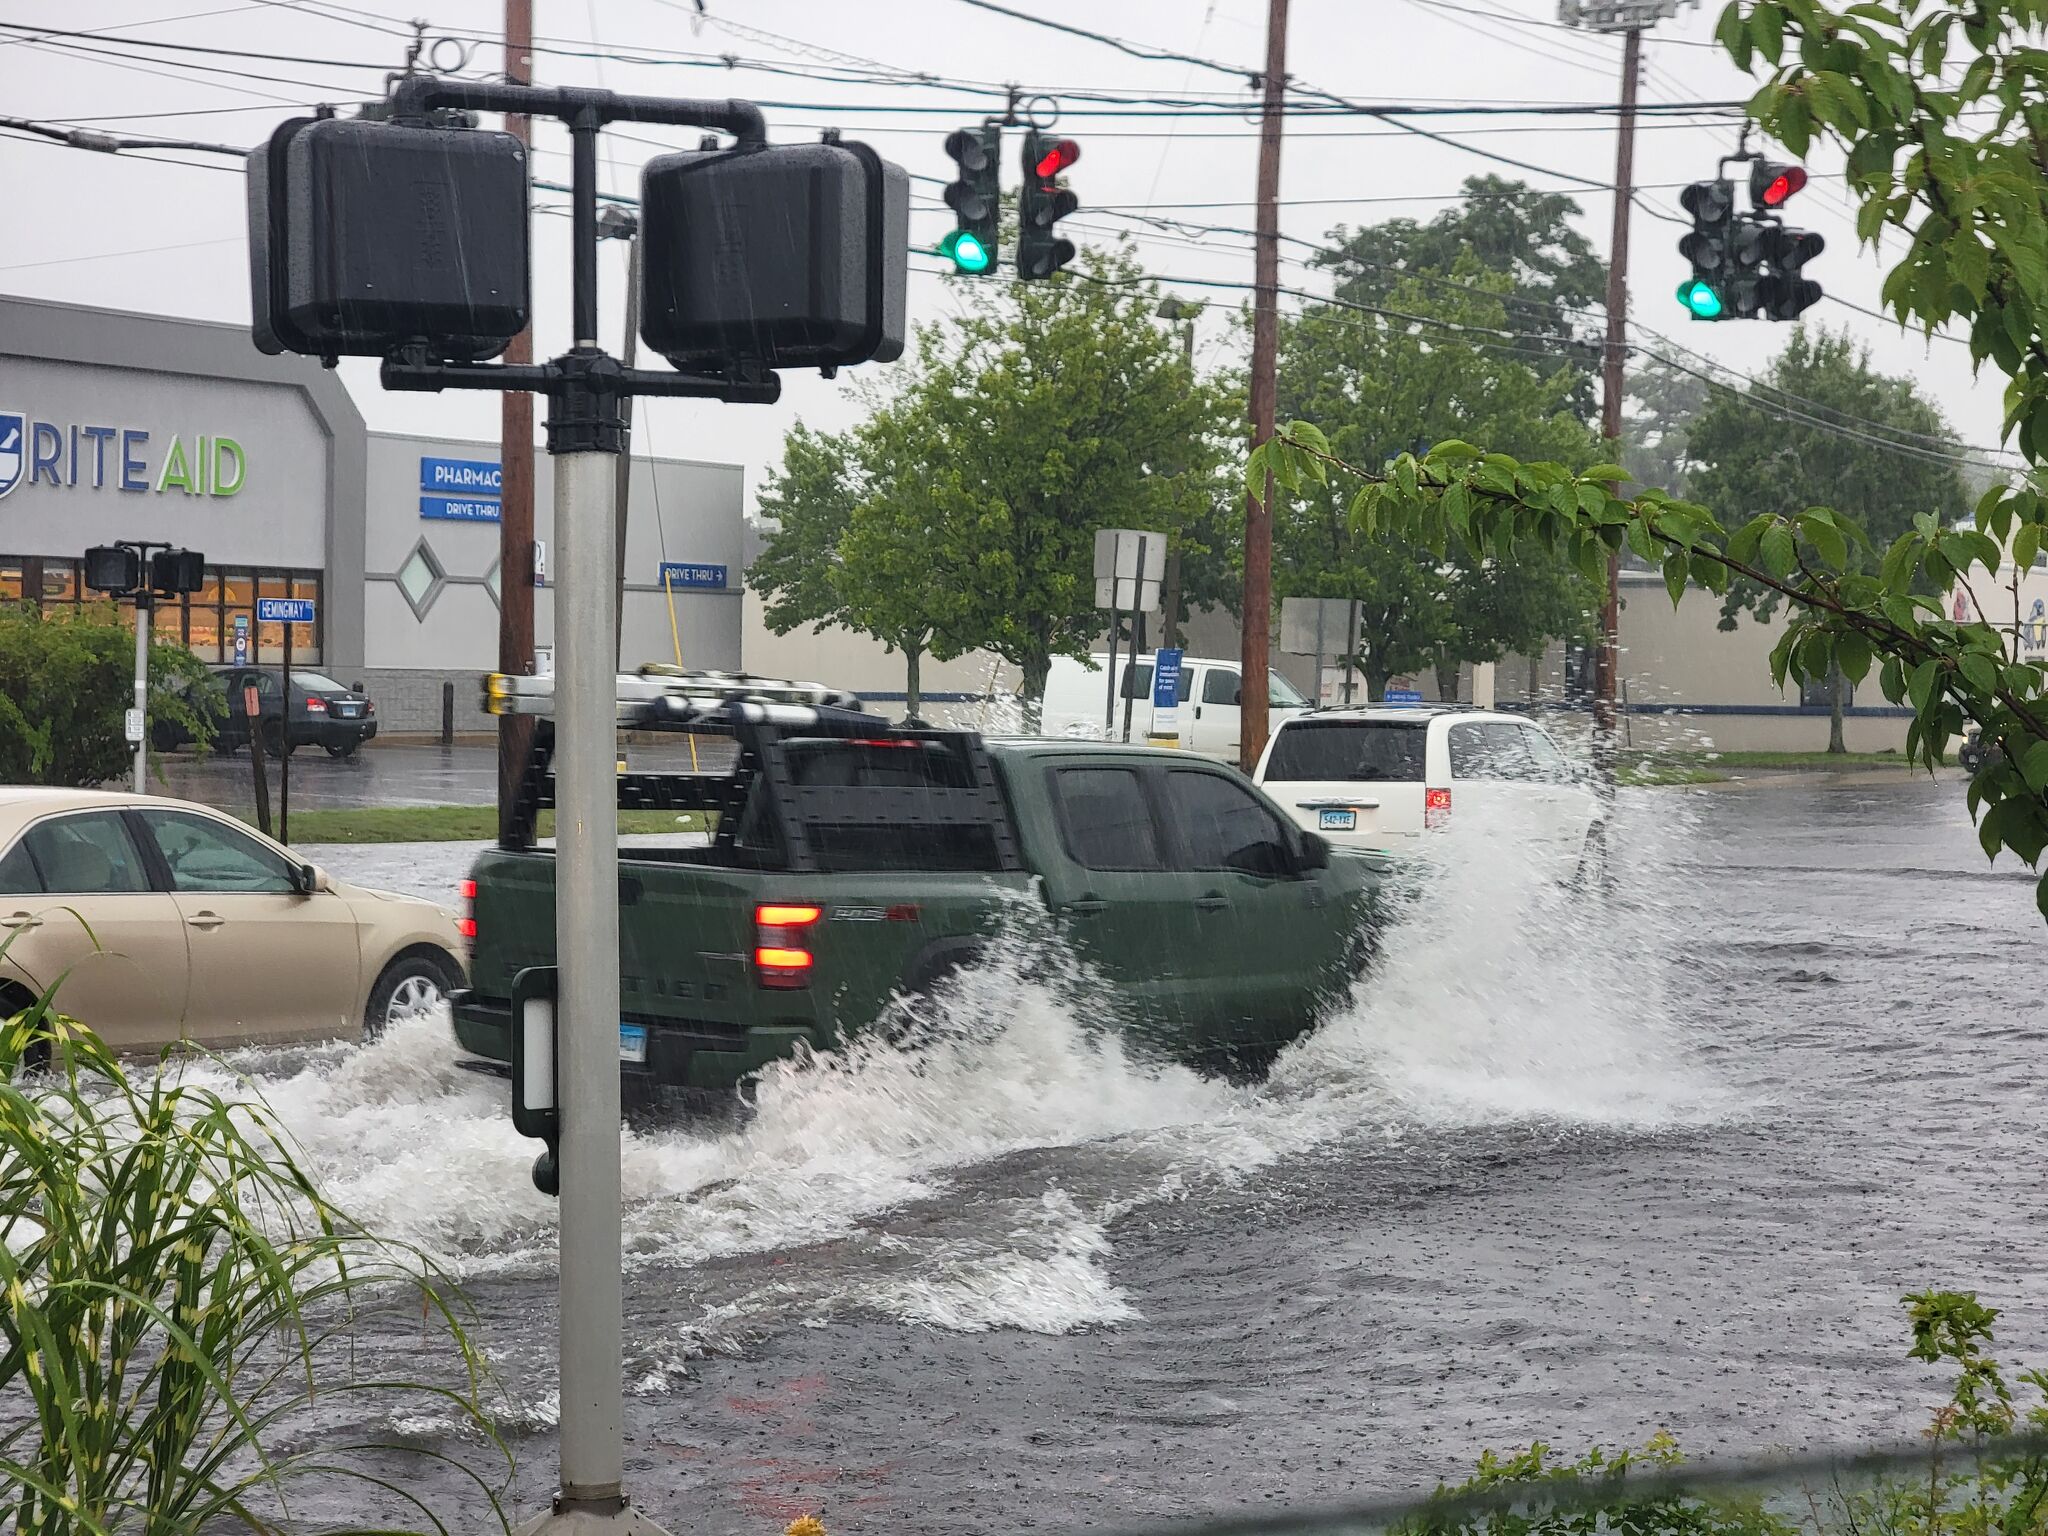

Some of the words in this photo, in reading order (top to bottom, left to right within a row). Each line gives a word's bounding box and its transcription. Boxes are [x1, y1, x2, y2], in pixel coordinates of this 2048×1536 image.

[28, 421, 150, 491] RITE
[155, 433, 246, 496] AID
[435, 465, 501, 487] PHARMAC
[446, 502, 473, 516] DRIVE
[475, 504, 500, 517] THRU
[665, 567, 690, 580] DRIVE
[691, 568, 713, 581] THRU
[262, 600, 305, 618] HEMINGWAY
